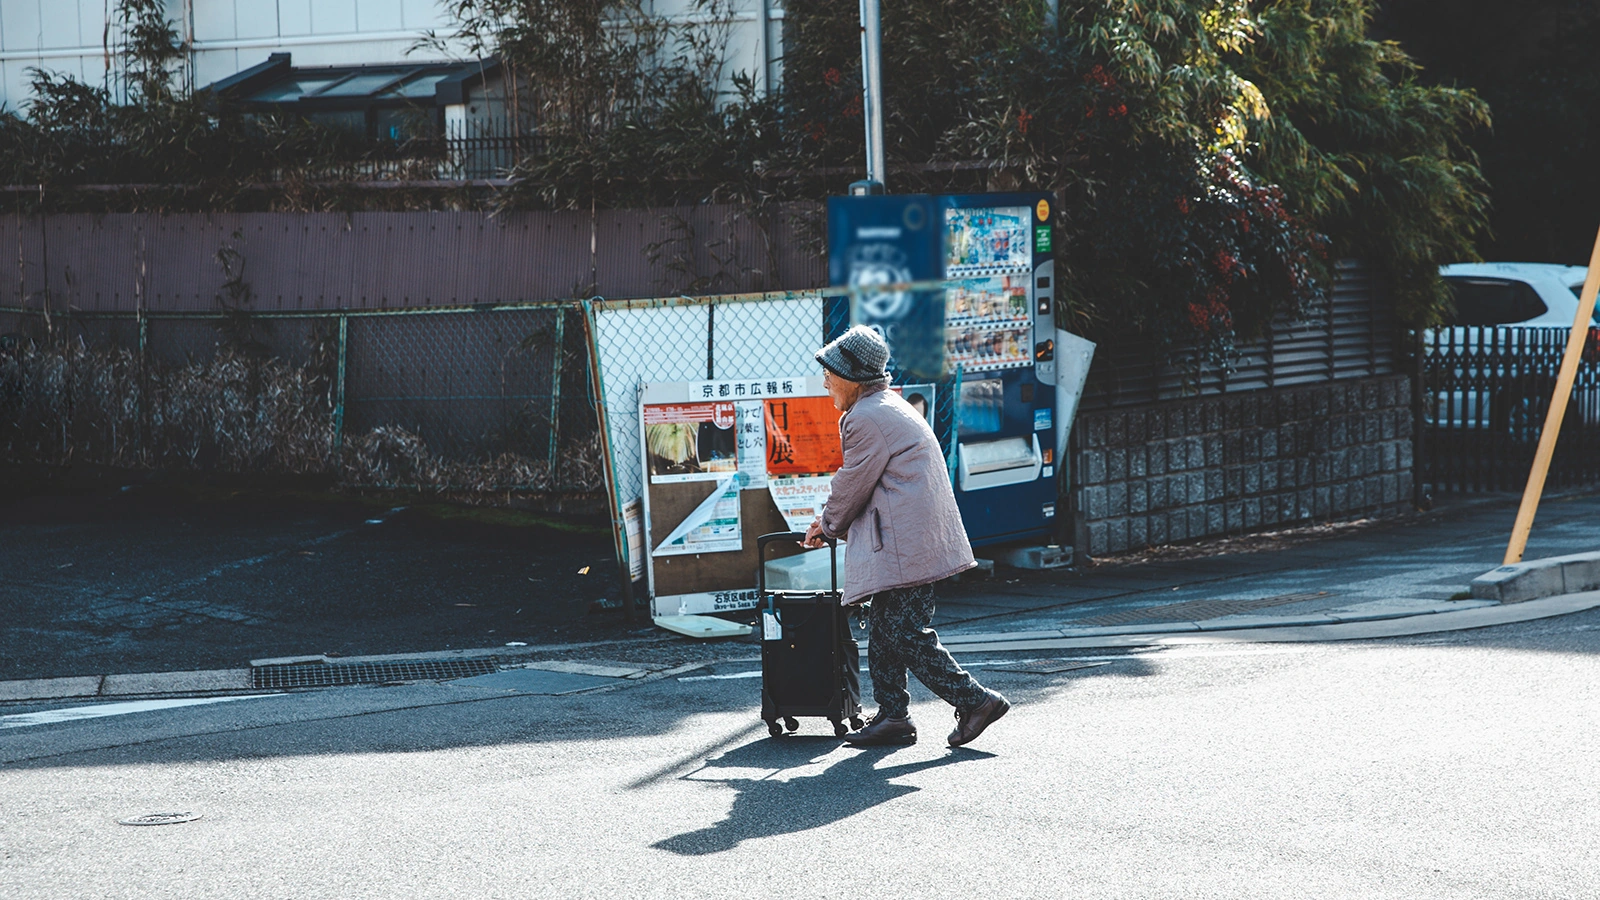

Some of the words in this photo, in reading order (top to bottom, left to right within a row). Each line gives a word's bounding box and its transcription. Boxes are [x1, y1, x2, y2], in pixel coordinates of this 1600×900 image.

[702, 380, 793, 398] 京都市広報板
[770, 402, 794, 464] 日展
